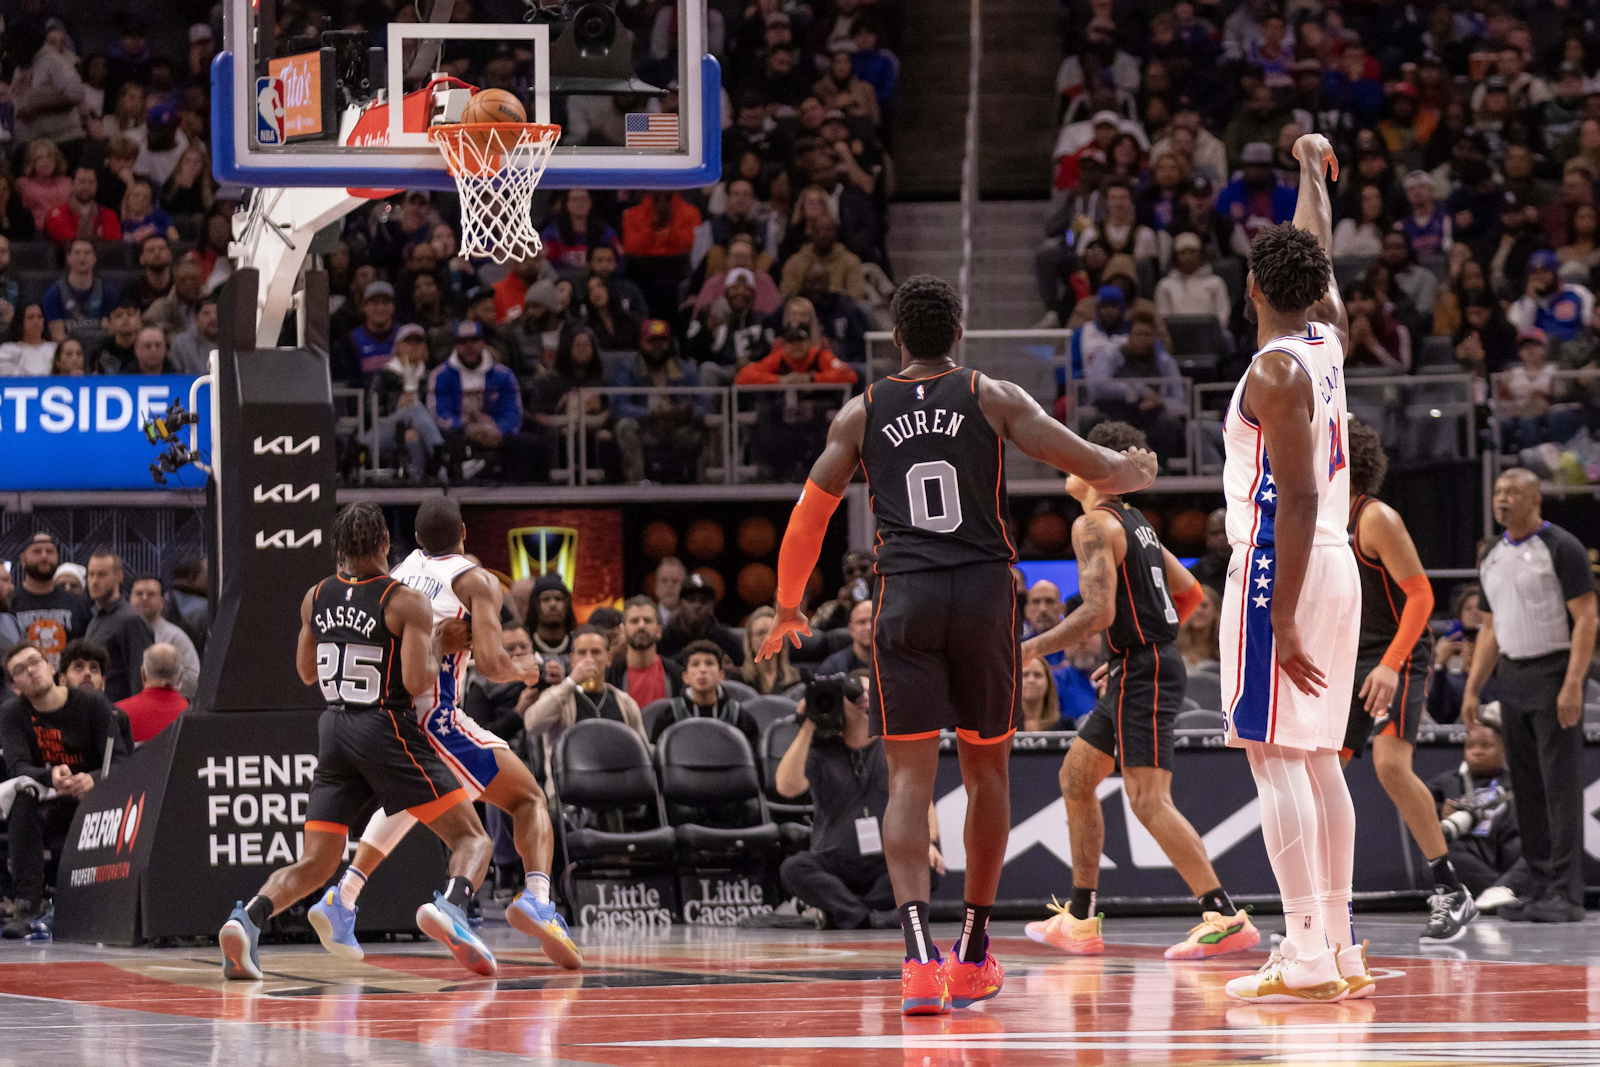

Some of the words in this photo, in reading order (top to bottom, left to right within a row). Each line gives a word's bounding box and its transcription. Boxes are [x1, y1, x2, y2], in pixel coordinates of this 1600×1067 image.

[261, 130, 276, 142] NBA
[0, 385, 170, 433] TSIDE
[882, 408, 965, 447] DUREN
[254, 435, 320, 455] KIA
[254, 483, 320, 503] KIA
[905, 459, 963, 533] 0
[255, 528, 322, 549] KIA
[1150, 566, 1179, 624] 7
[315, 605, 377, 639] SASSER
[316, 642, 383, 705] 25
[198, 754, 319, 788] HENR
[78, 808, 123, 851] BELFOR
[596, 882, 660, 909] Little
[699, 879, 763, 904] Little
[580, 904, 672, 927] Caesars
